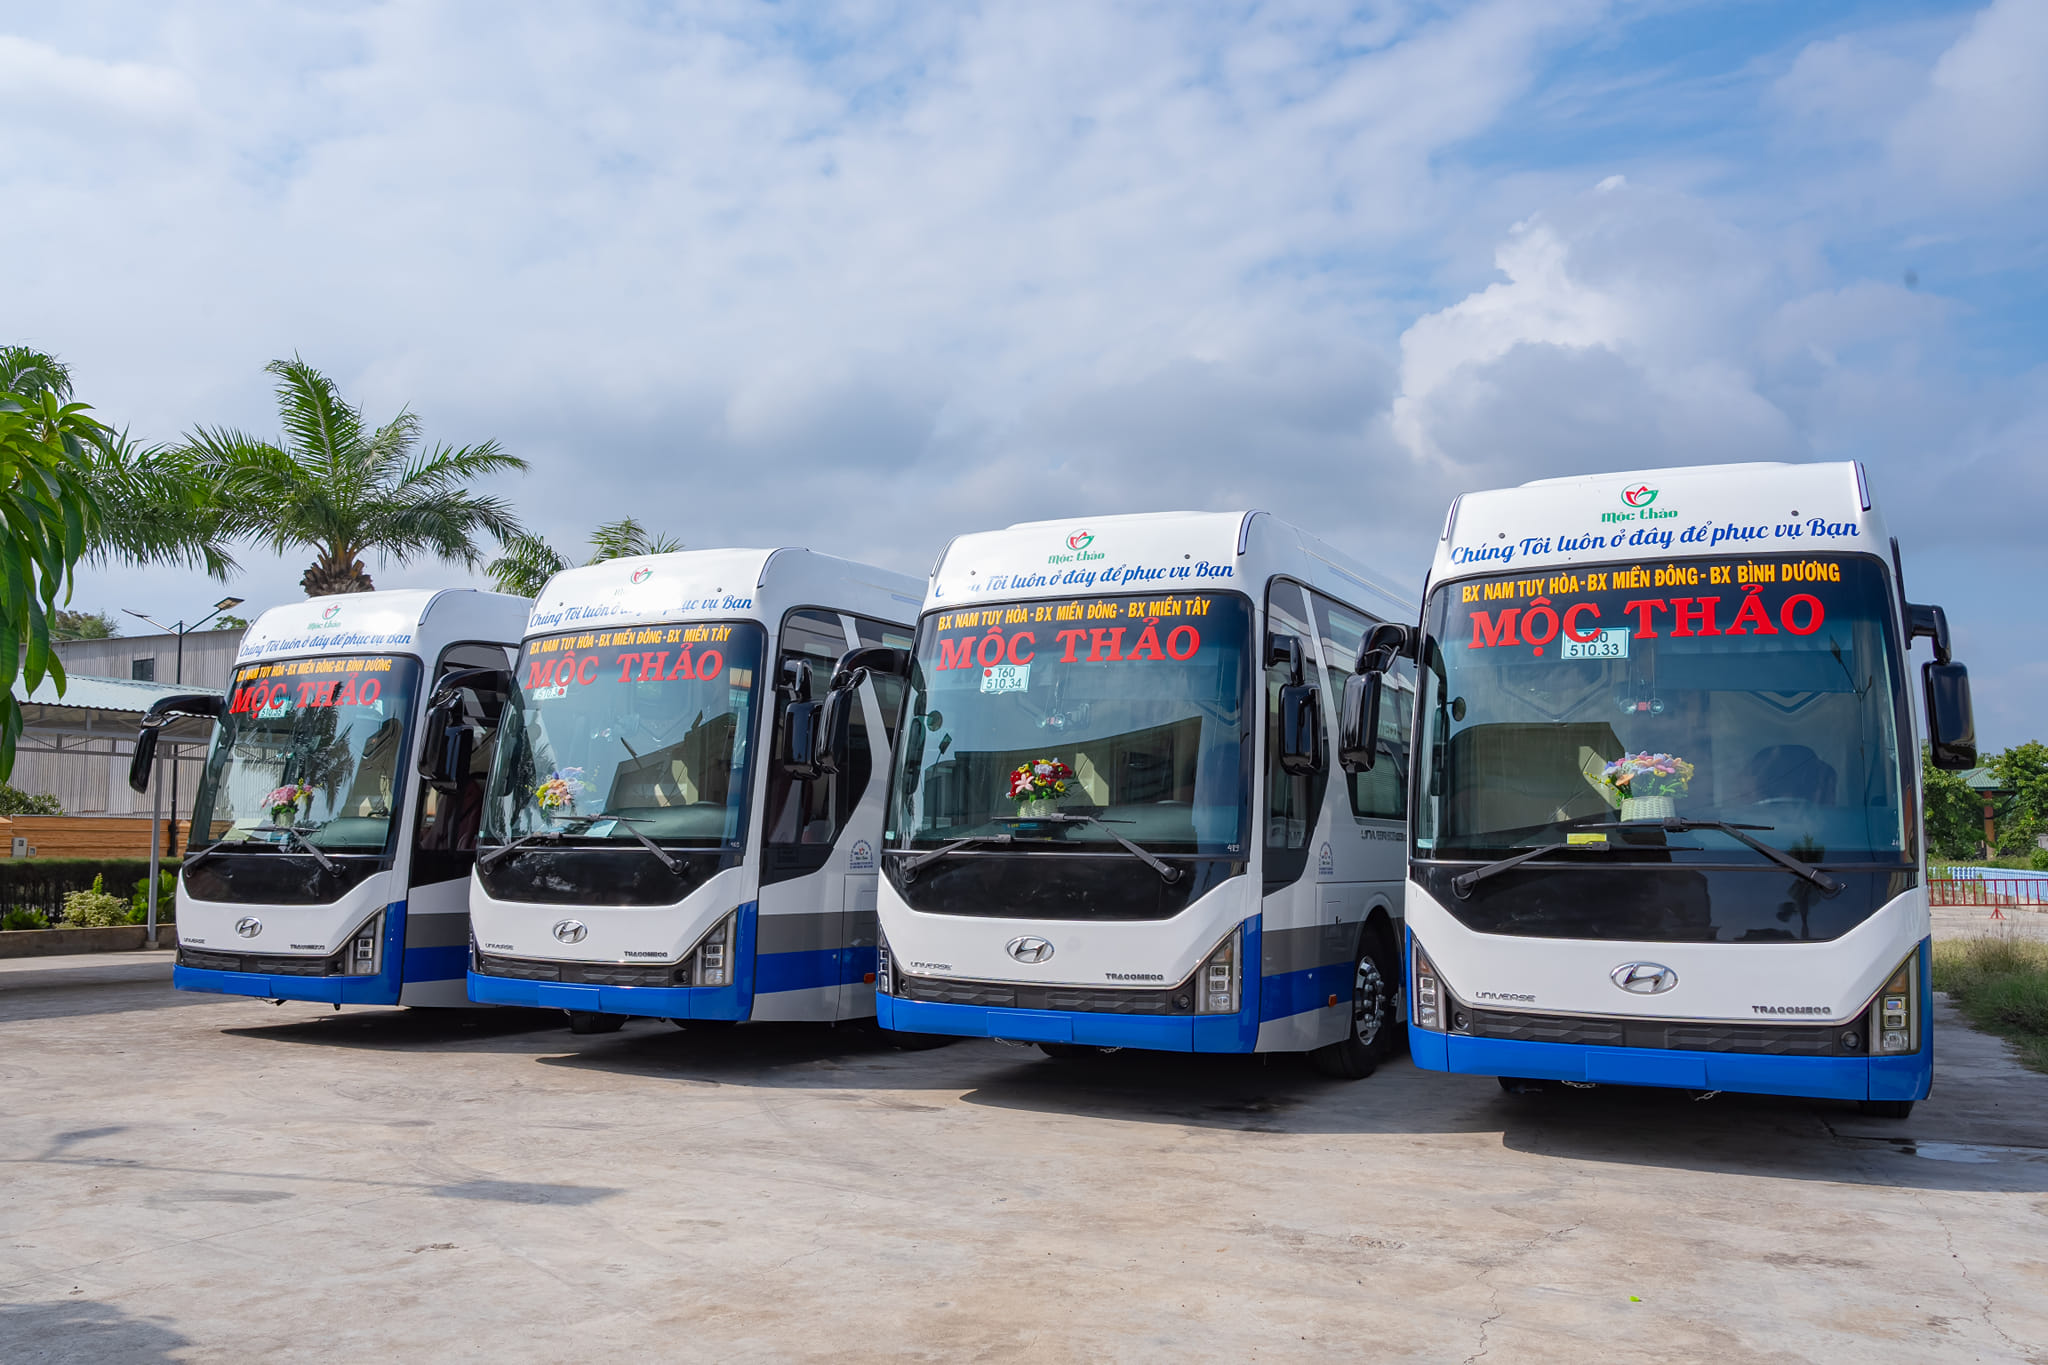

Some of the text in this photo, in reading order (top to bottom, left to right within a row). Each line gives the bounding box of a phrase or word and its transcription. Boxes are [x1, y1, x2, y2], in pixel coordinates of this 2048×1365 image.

[1451, 518, 1861, 565] Chúng Tôi luôn ở đây để phục vụ Bạn
[986, 575, 1009, 591] Tôi
[1011, 572, 1047, 589] luôn
[1050, 569, 1062, 586] ở
[1063, 568, 1097, 588] đây
[1100, 563, 1127, 582] để
[1121, 565, 1167, 586] phục
[1169, 566, 1191, 580] vụ
[1195, 561, 1234, 580] Bạn
[1462, 585, 1481, 603] BX
[1484, 582, 1515, 600] NAM
[1517, 578, 1546, 597] TUY
[1612, 565, 1651, 589] MIỀN
[1737, 560, 1776, 583] BÌNH
[1782, 560, 1841, 582] DƯƠNG
[722, 594, 753, 612] Bạn
[938, 615, 953, 631] BX
[955, 612, 979, 628] NAM
[982, 610, 1003, 626] TUY
[1056, 601, 1084, 621] MIỀN
[1149, 595, 1182, 617] MIỀN
[1185, 596, 1211, 616] TÂY
[1467, 584, 1825, 657] MỘC THẢO
[541, 638, 560, 653] NAM
[560, 637, 577, 651] TUY
[683, 624, 710, 642] MIỀN
[711, 624, 732, 642] TÂY
[936, 617, 1200, 677] MỘC THẢO
[1570, 643, 1619, 657] 510.33
[524, 642, 723, 696] MỘC THẢO
[986, 678, 1023, 689] 510.34
[229, 672, 381, 719] MỘC THẢO
[1475, 991, 1536, 1002] UNIVERSE
